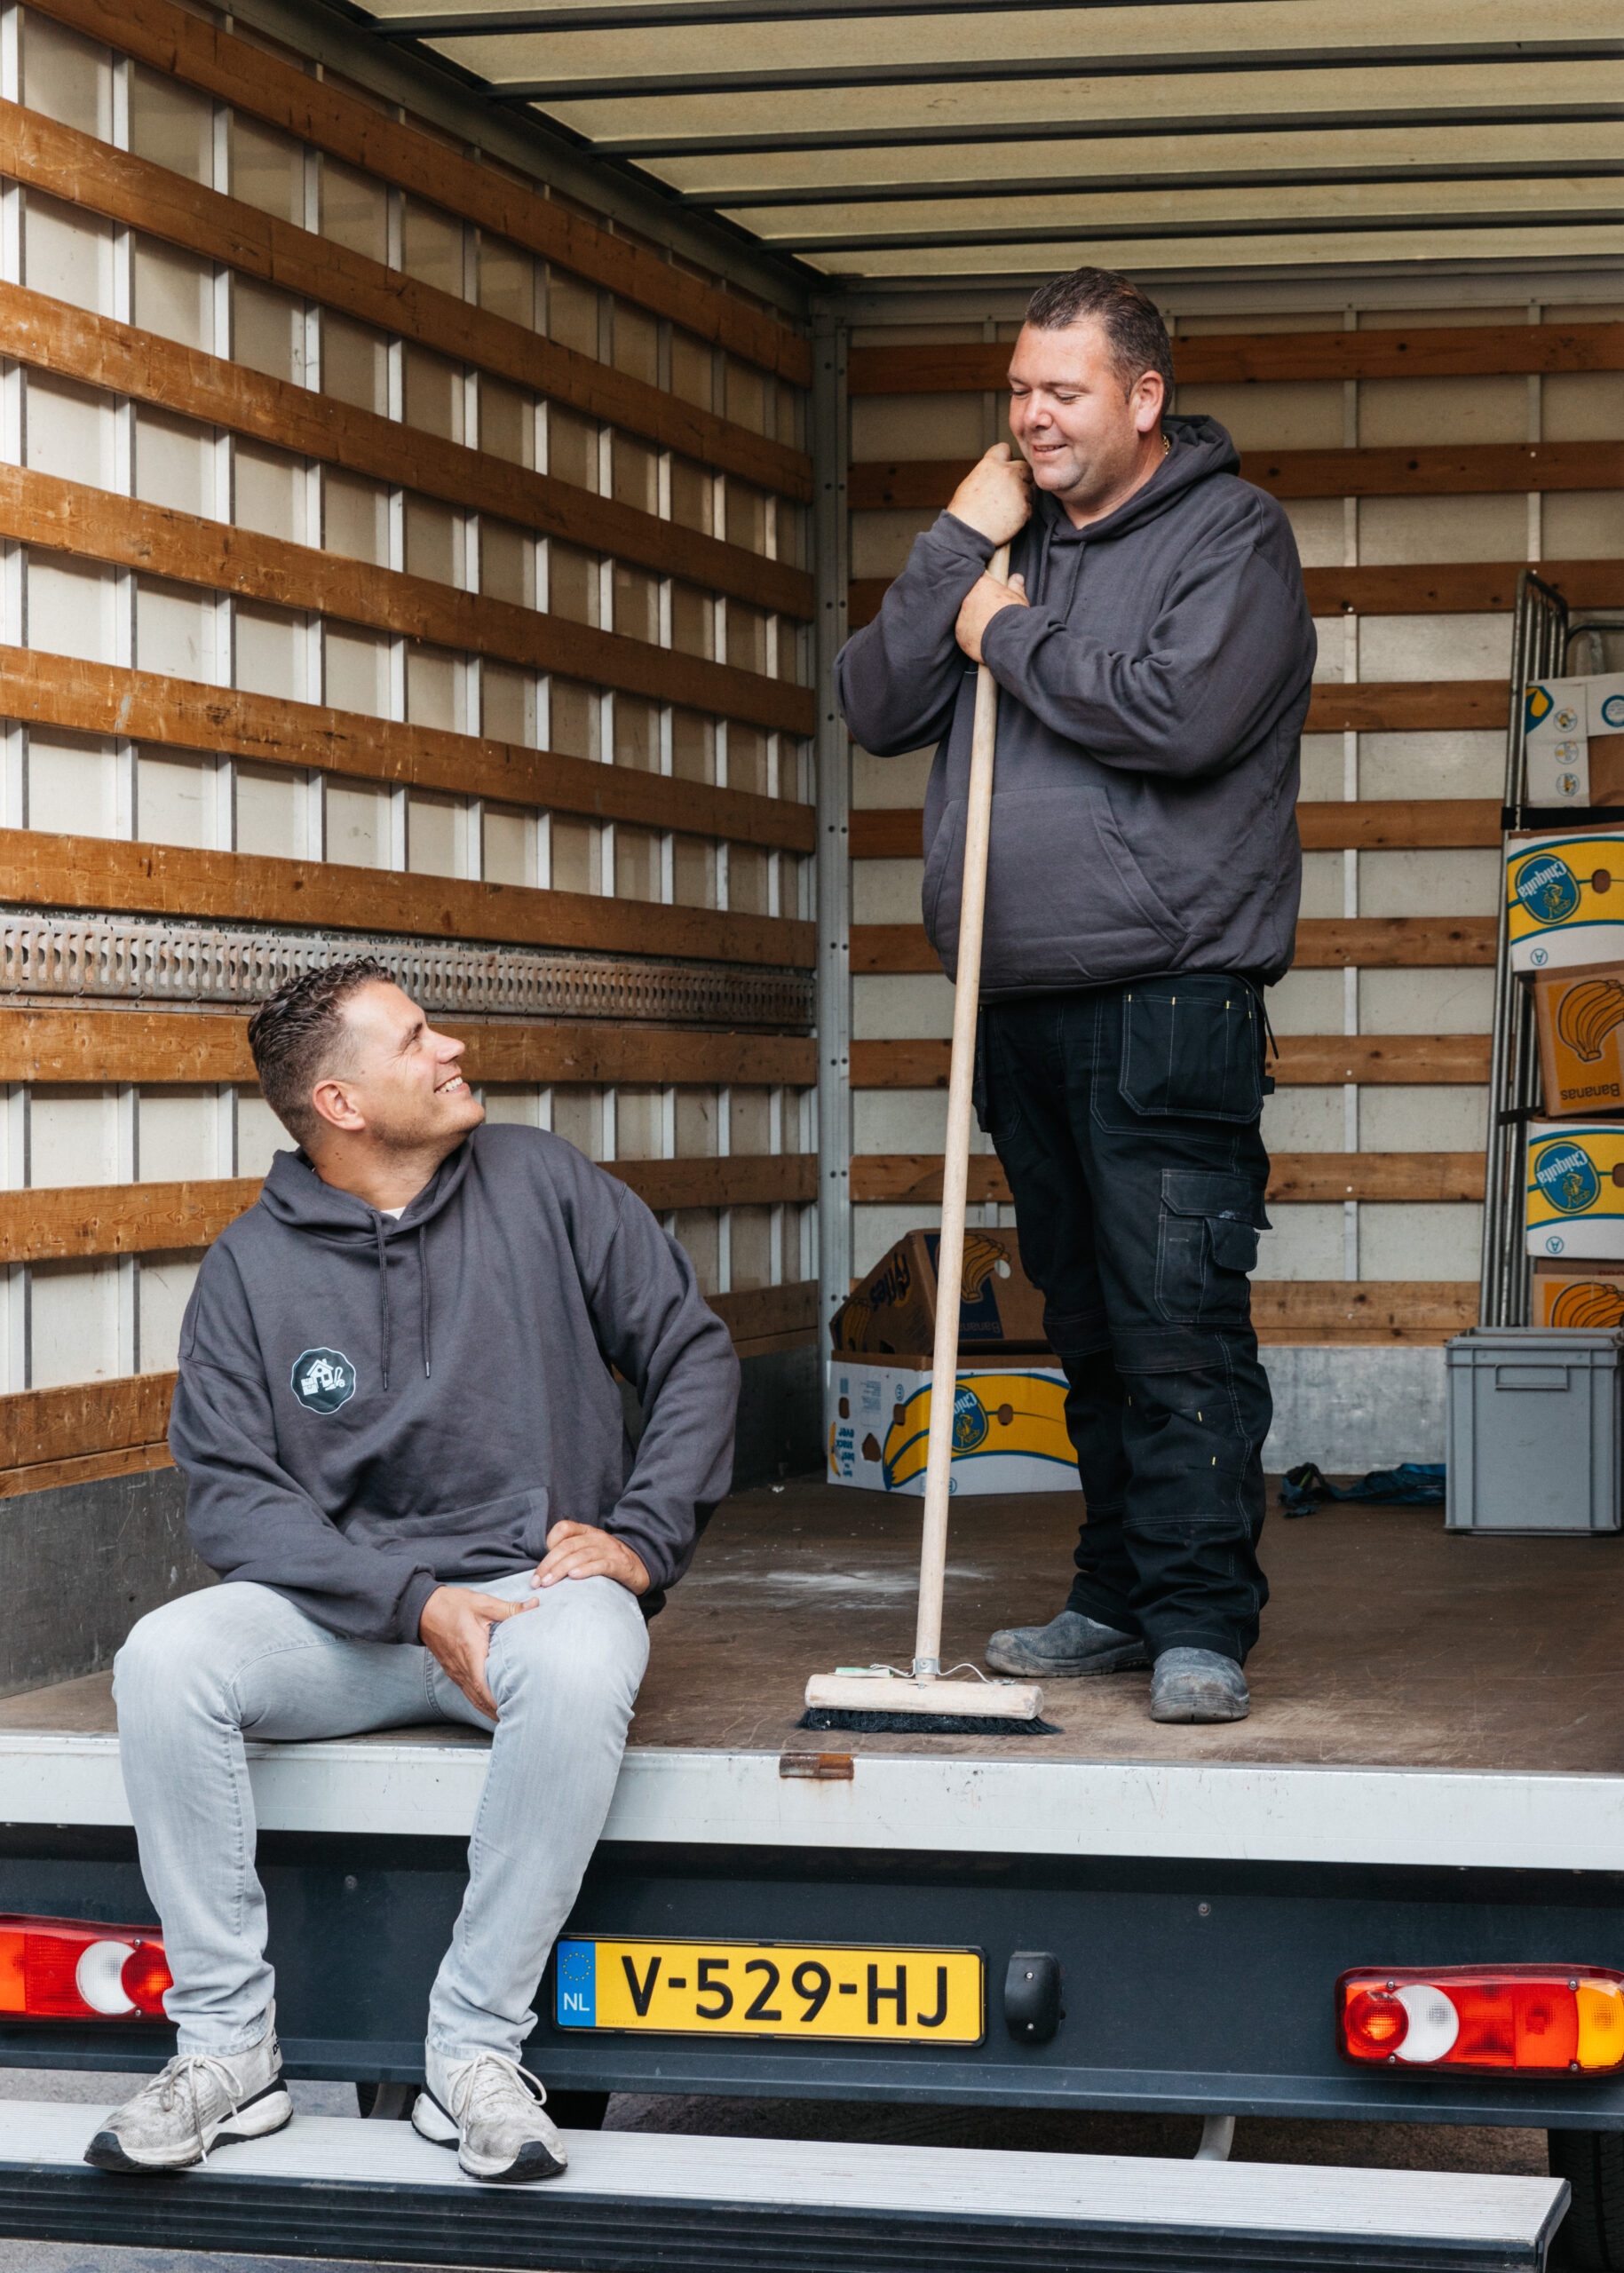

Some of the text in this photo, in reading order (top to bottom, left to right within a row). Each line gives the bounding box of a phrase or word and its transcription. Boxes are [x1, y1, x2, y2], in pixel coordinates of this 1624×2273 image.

[1517, 860, 1567, 899] Chiquita
[1561, 1082, 1620, 1100] Bananas
[1536, 1150, 1588, 1184] Chiquita
[562, 1992, 590, 2012] NL
[621, 1955, 947, 2028] V-529-HJ
